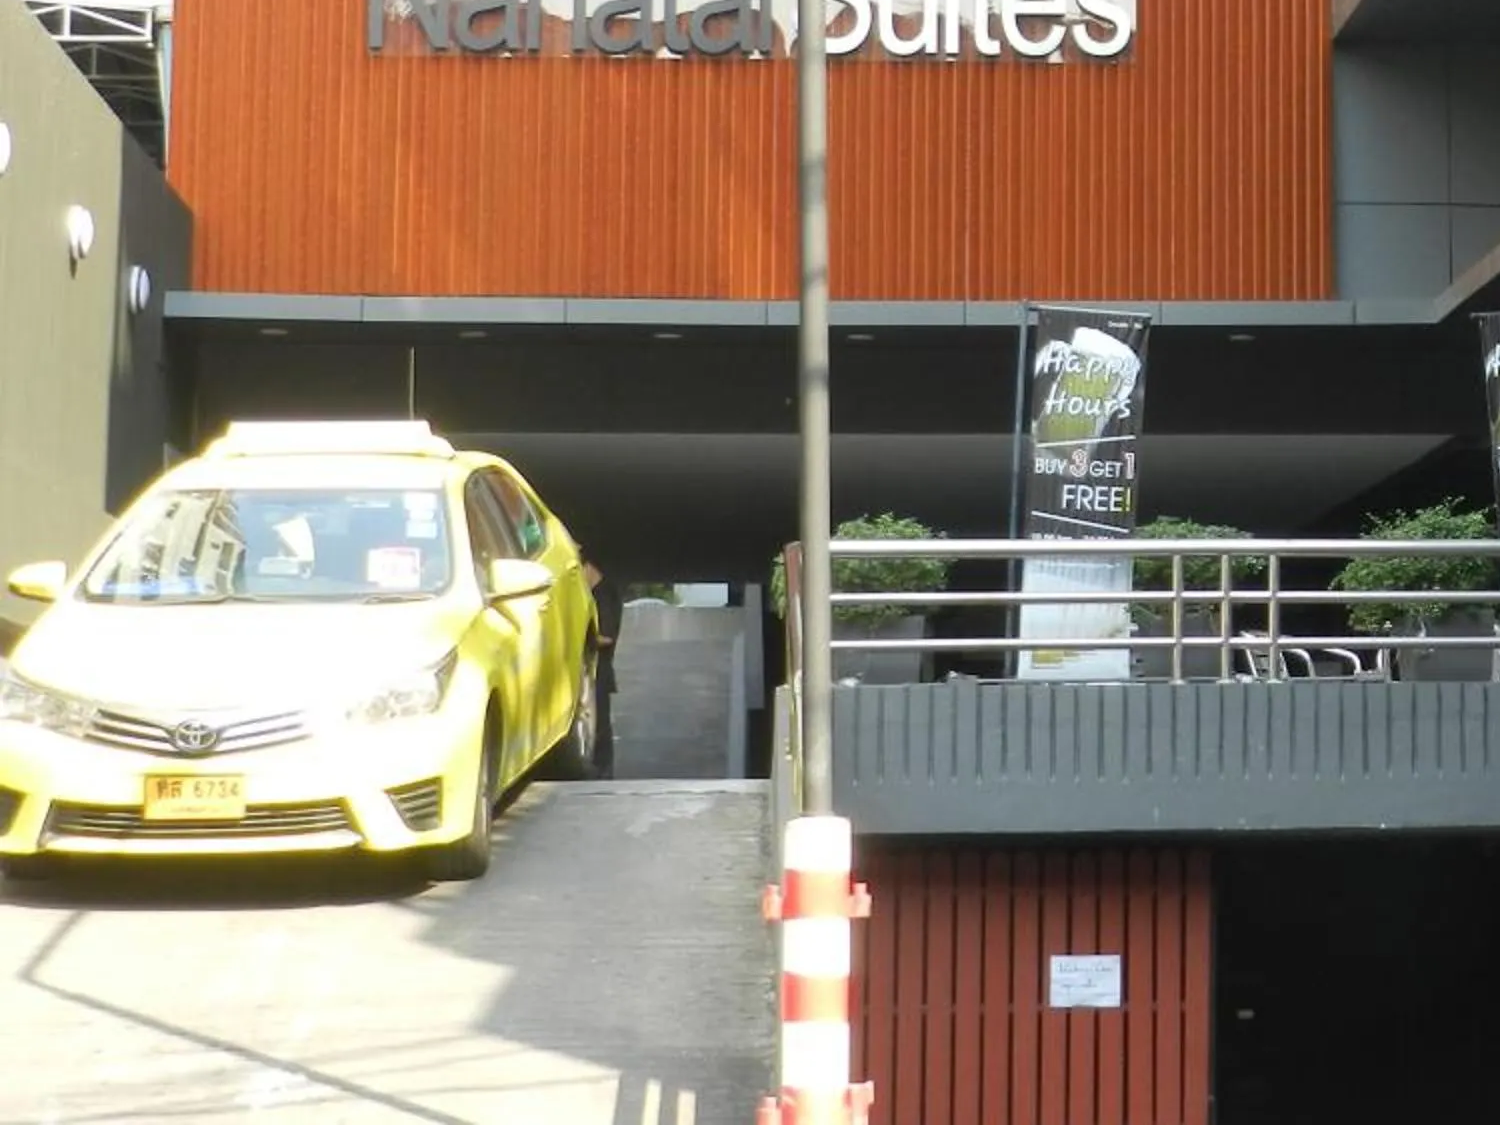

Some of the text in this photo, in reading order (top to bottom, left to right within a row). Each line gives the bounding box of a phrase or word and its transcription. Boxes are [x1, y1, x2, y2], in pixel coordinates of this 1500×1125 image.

[1043, 341, 1138, 385] Happy
[1045, 382, 1131, 420] Hours
[1034, 448, 1135, 480] BUY 3 GET 1
[1061, 484, 1132, 512] FREE!
